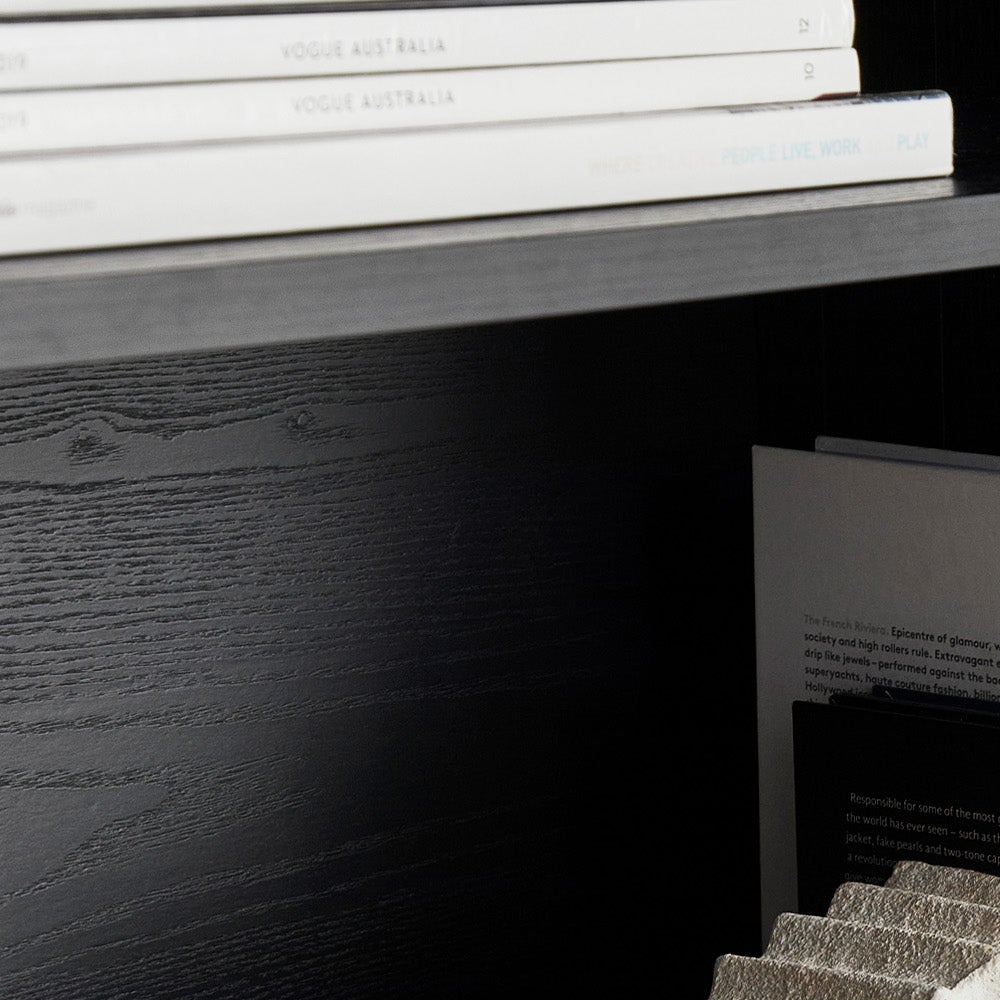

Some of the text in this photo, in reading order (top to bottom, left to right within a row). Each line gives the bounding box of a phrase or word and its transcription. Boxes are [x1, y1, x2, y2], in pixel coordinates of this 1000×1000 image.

[281, 36, 446, 60] VOGUE AUSTRALIA
[804, 62, 814, 81] 10
[292, 89, 455, 113] VOGUE AUSTRALIA
[721, 142, 777, 165] PEOPLE
[818, 136, 863, 158] WORK
[896, 131, 931, 153] PLAY
[822, 617, 852, 630] French
[891, 626, 935, 642] Epicentre
[937, 633, 948, 644] of
[949, 635, 992, 651] glamour,
[804, 632, 837, 647] society
[838, 638, 856, 648] and
[858, 638, 879, 653] high
[881, 643, 909, 655] rollers
[911, 647, 933, 659] rule.
[934, 649, 994, 668] Extravagant
[804, 649, 823, 661] drip
[824, 651, 841, 662] like
[929, 668, 965, 681] against
[968, 671, 984, 683] the
[804, 666, 863, 683] superyachts,
[865, 673, 893, 687] haute
[894, 680, 931, 691] couture
[850, 792, 901, 809] Responsible
[903, 799, 916, 811] for
[918, 804, 942, 815] some
[943, 806, 954, 817] of
[955, 807, 971, 820] the
[972, 812, 995, 823] most
[846, 812, 861, 824] the
[862, 815, 888, 828] world
[889, 819, 905, 830] has
[906, 822, 925, 833] ever
[927, 825, 948, 836] seen
[958, 829, 979, 840] such
[981, 833, 990, 842] as
[876, 835, 895, 848] fake
[896, 839, 924, 853] pearls
[924, 844, 942, 855] and
[943, 847, 985, 861] two-tone
